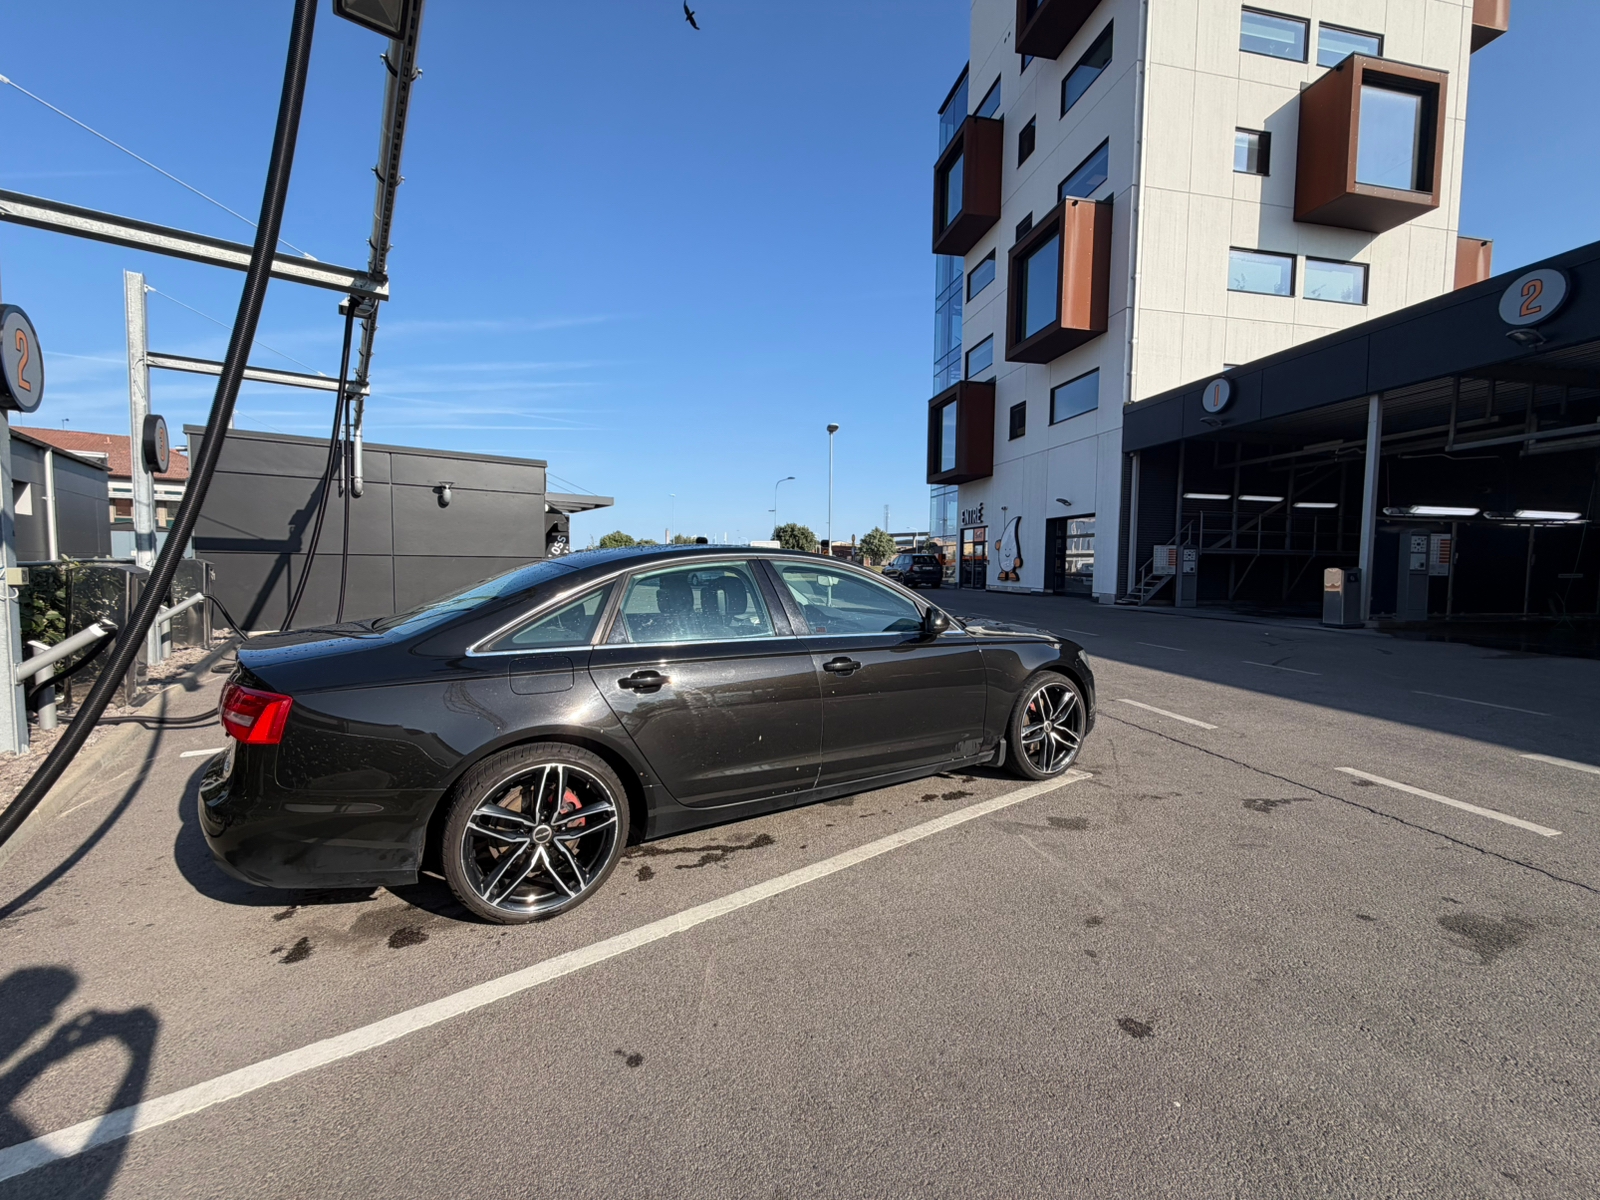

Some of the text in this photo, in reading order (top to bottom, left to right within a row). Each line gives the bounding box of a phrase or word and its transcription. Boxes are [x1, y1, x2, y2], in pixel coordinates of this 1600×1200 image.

[1519, 278, 1543, 318] 2
[15, 328, 31, 391] 2
[961, 502, 984, 525] ENTRÉ
